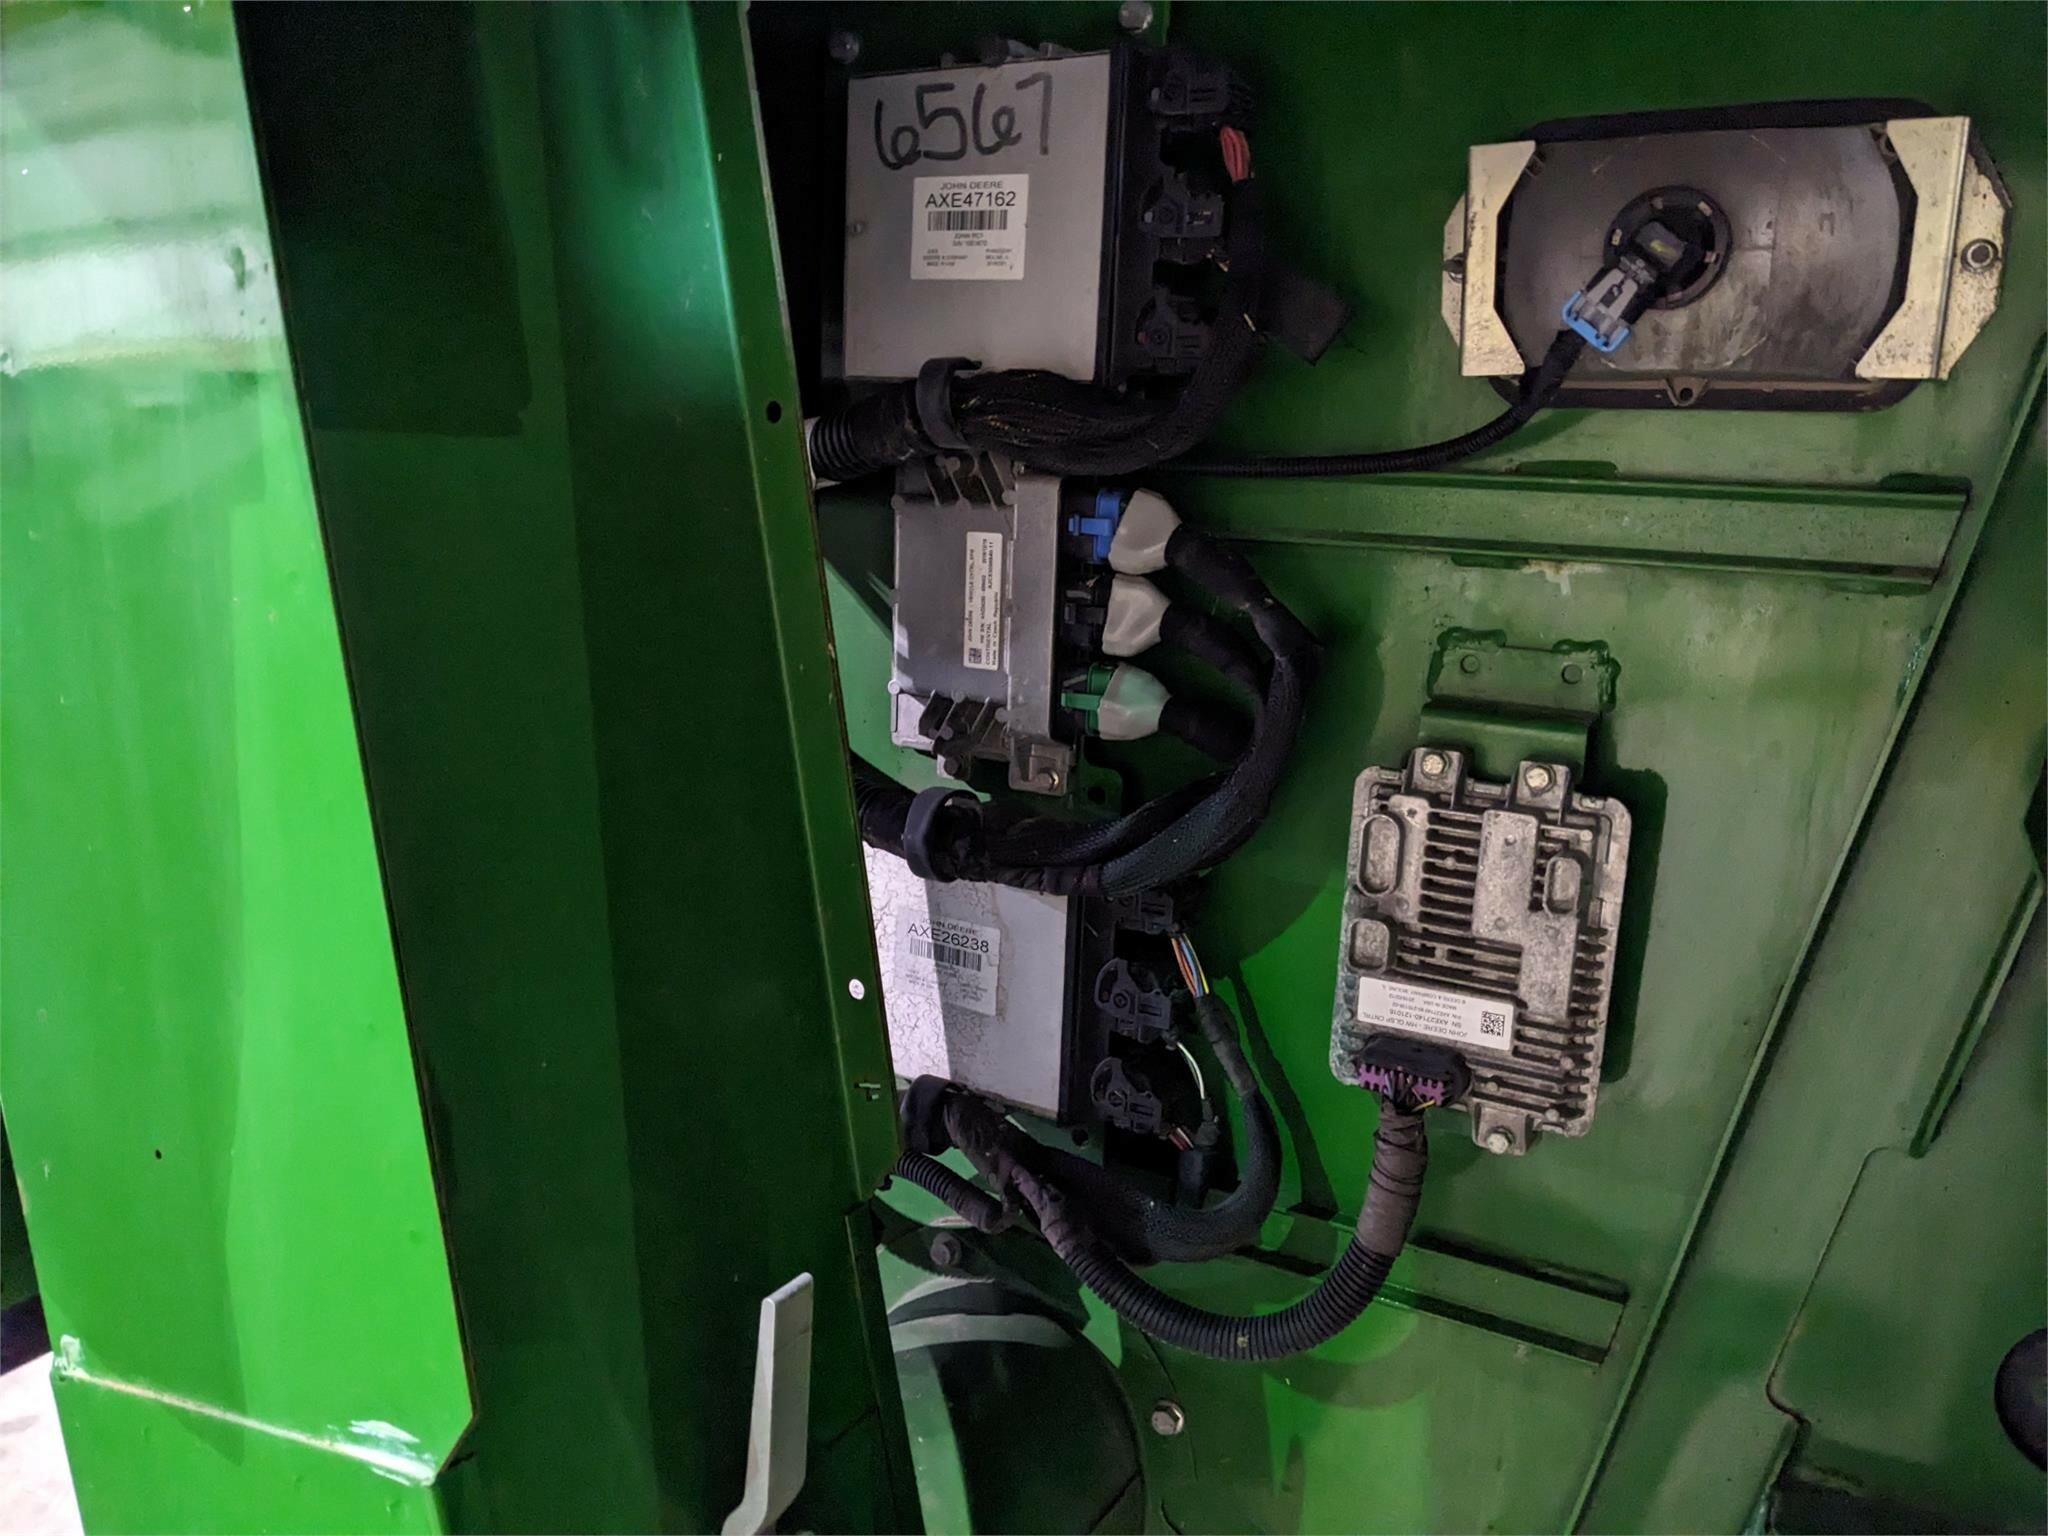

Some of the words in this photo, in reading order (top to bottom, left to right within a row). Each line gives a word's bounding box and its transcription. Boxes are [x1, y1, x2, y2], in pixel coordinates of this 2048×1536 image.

[874, 72, 1052, 169] 6567
[940, 182, 967, 191] JOHN
[969, 181, 1003, 189] DEERE
[925, 191, 1016, 209] AXE47162
[907, 922, 990, 953] AXE26238
[1363, 1011, 1385, 1021] CNTRL
[1424, 1024, 1447, 1034] DEERE
[1449, 1028, 1468, 1037] JOHN
